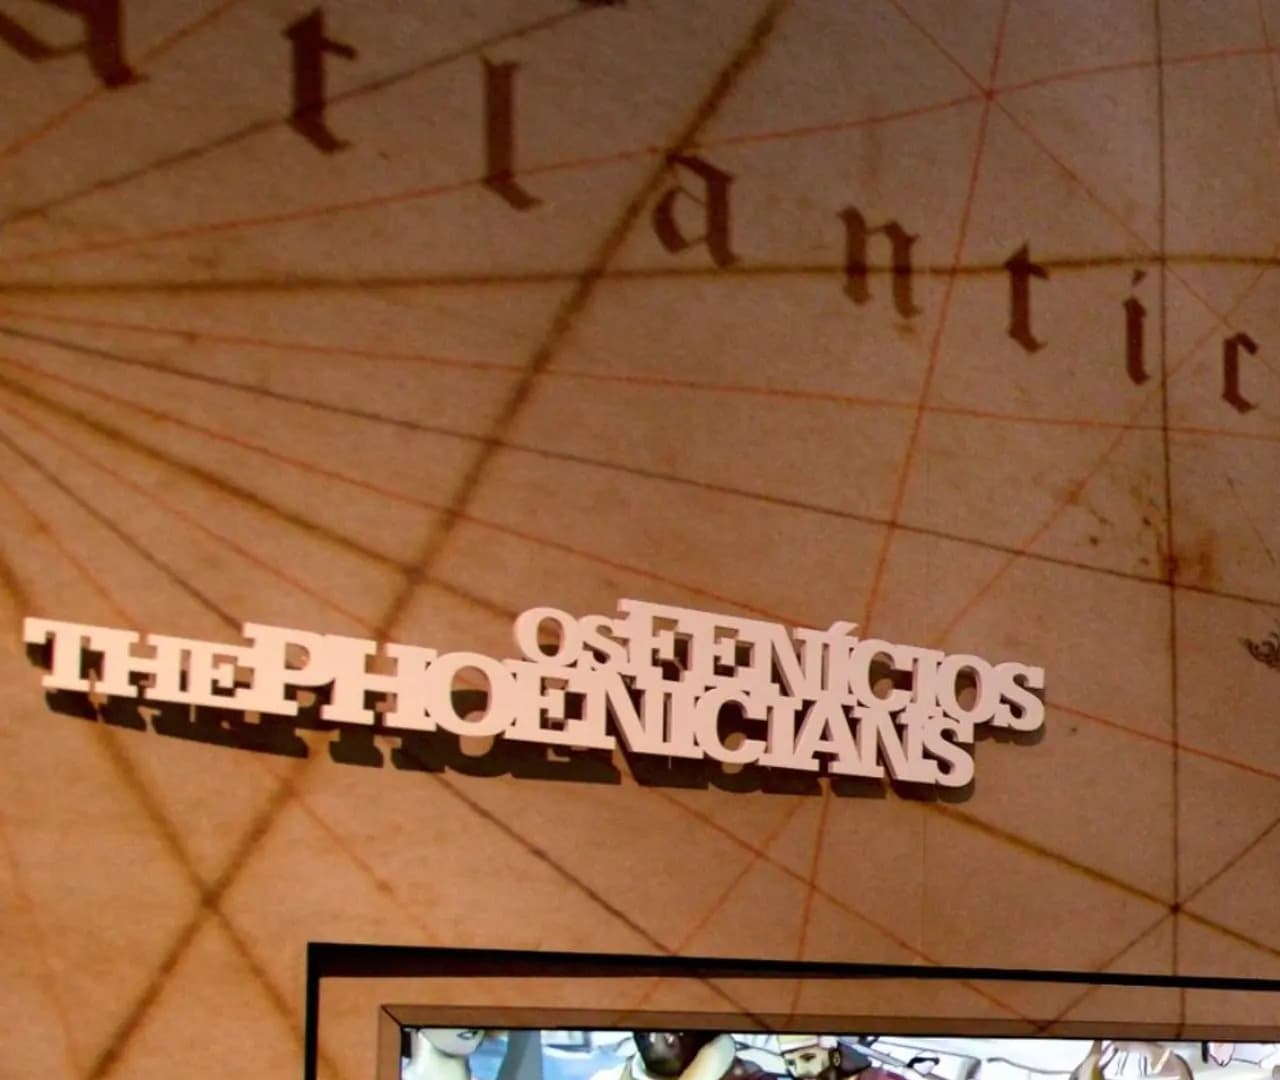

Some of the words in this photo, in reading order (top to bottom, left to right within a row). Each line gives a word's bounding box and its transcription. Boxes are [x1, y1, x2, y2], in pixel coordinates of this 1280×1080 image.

[23, 616, 254, 706] THE
[243, 621, 975, 787] PHOENICIANS
[514, 606, 629, 671] OS
[616, 598, 1044, 732] FENÍCIOS
